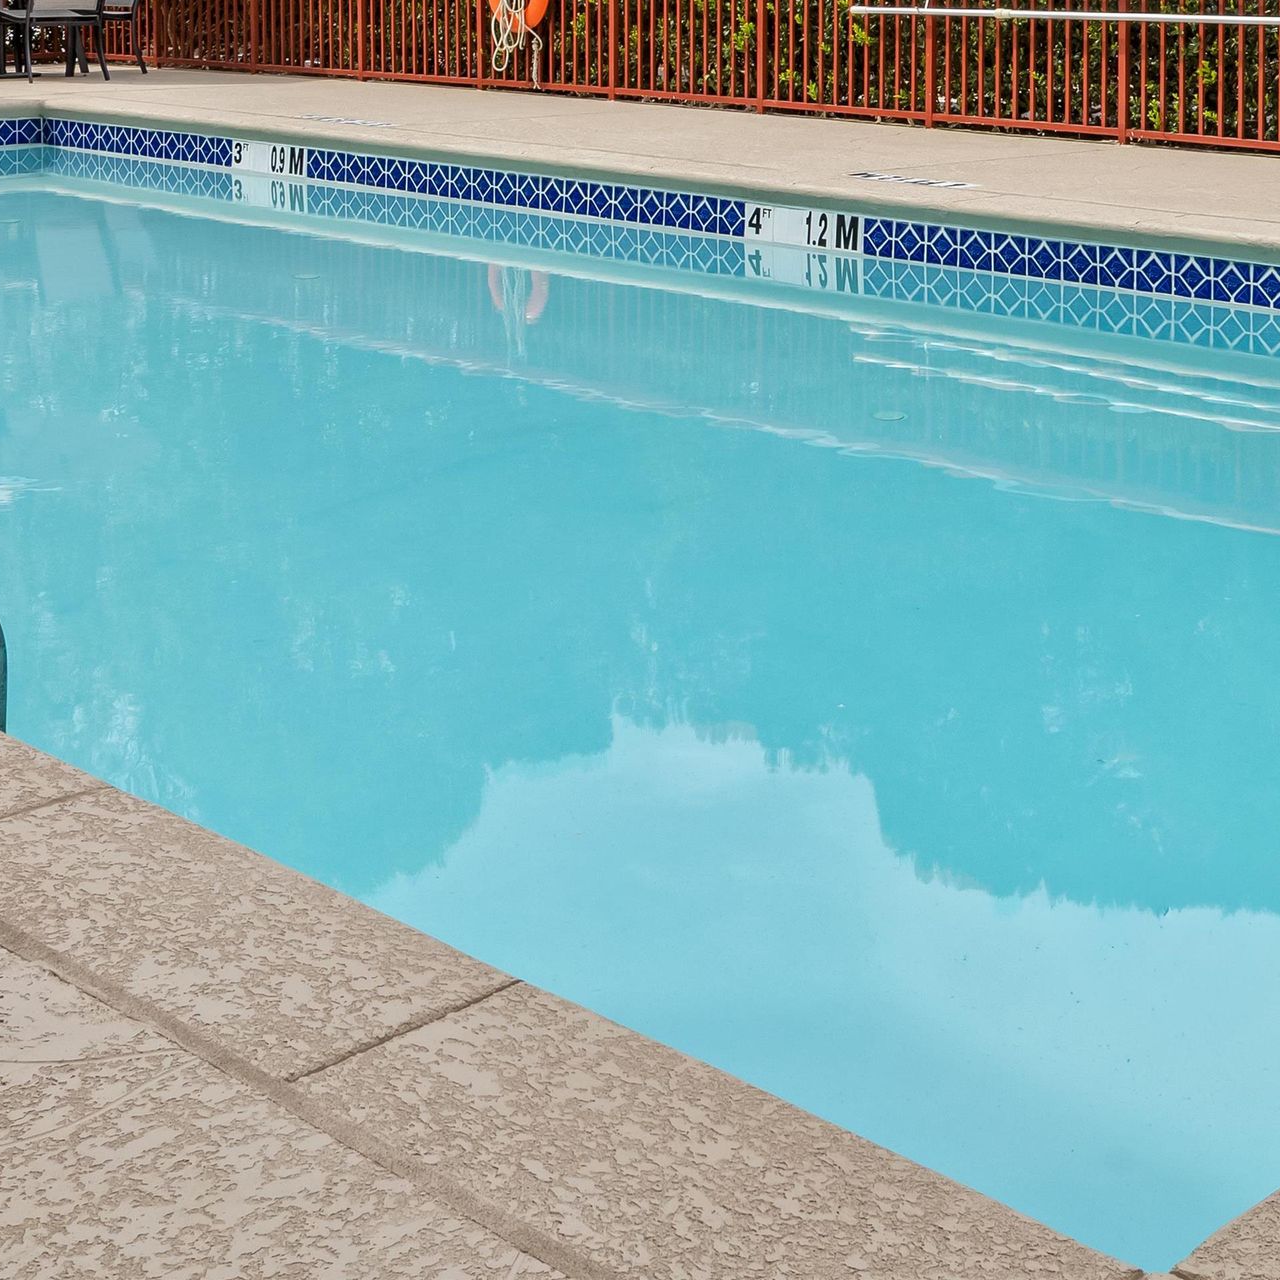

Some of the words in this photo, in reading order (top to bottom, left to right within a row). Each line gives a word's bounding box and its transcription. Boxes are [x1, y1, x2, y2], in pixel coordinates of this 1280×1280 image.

[270, 145, 285, 173] 0.9
[288, 147, 304, 176] M
[806, 211, 828, 248] 1.2
[835, 214, 859, 251] M
